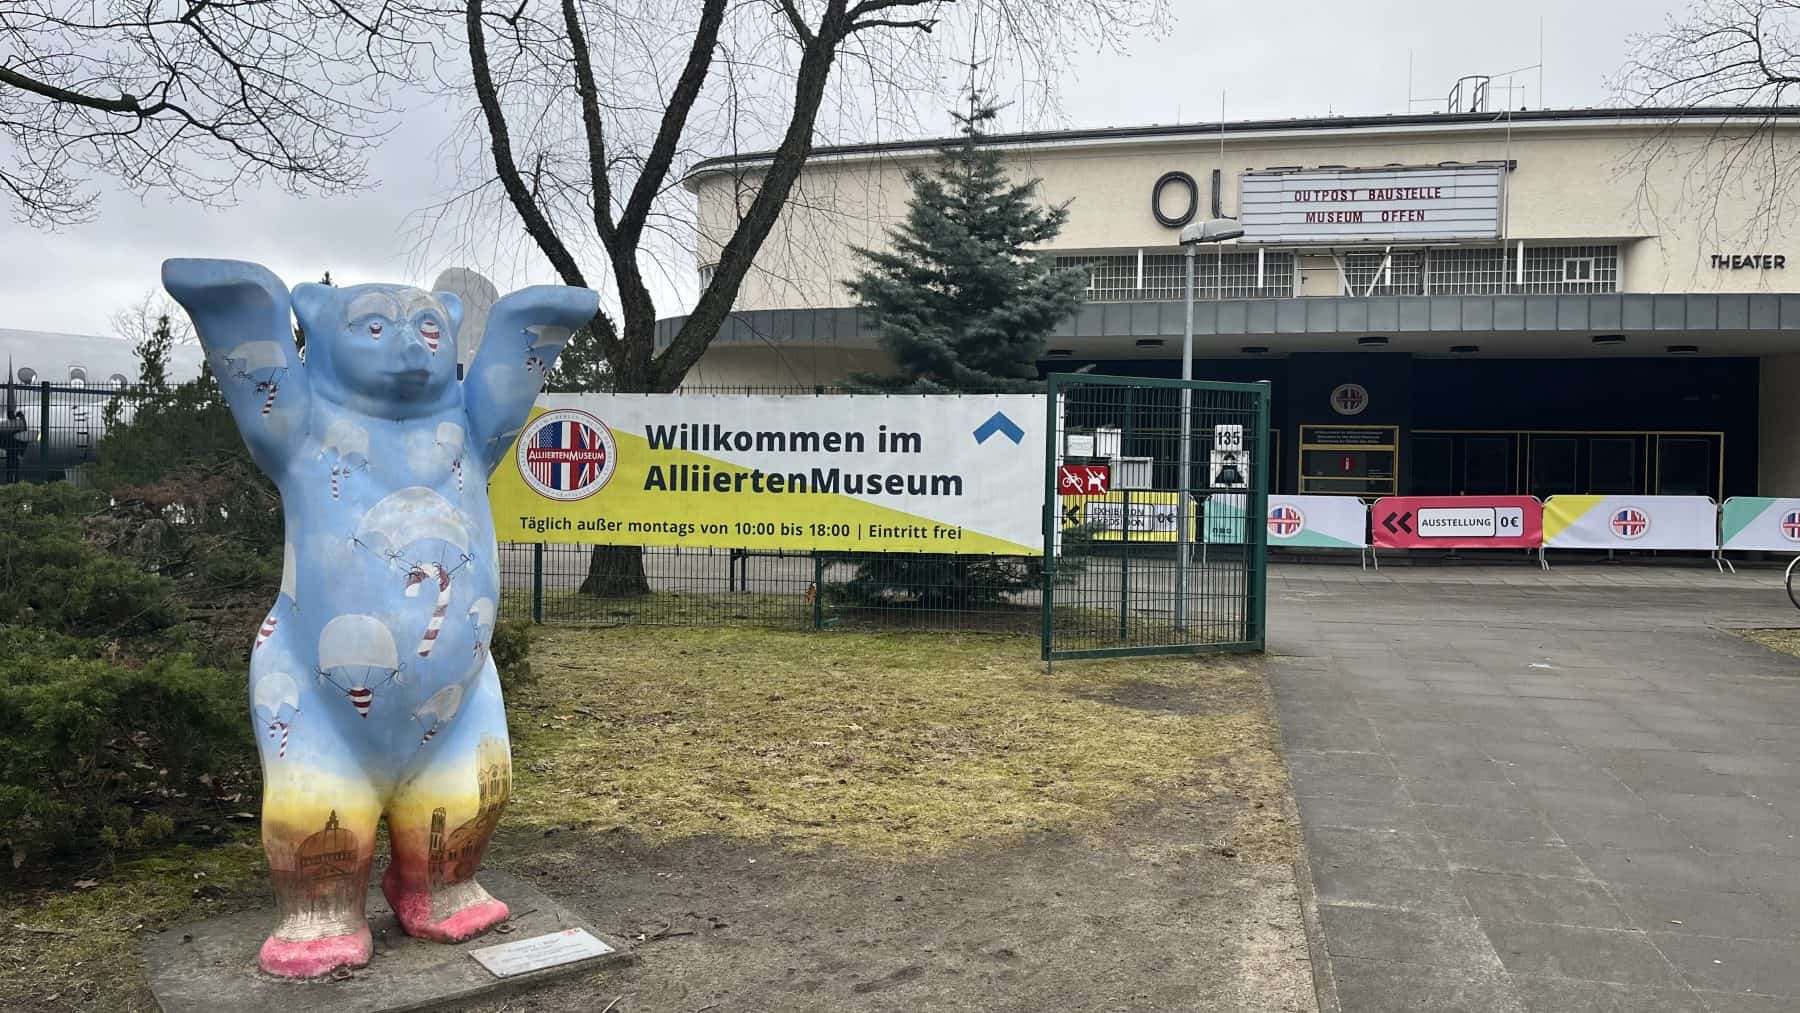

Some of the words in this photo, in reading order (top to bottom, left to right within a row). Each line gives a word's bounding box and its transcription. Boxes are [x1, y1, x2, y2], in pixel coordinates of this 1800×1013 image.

[1294, 190, 1356, 202] OUTPOST
[1368, 187, 1441, 200] BAUSTELLE
[1306, 211, 1363, 223] MUSEUM
[1381, 209, 1425, 222] OFFEN
[1711, 254, 1786, 269] THEATER
[645, 423, 865, 452] Willkommen
[878, 425, 922, 453] im
[1218, 431, 1240, 445] 135
[643, 464, 963, 496] AlliiertenMuseum
[520, 516, 572, 532] Täglich
[577, 518, 623, 531] außer
[628, 519, 695, 536] montags
[701, 523, 728, 534] von
[735, 522, 775, 535] 10:00
[781, 522, 803, 536] bis
[809, 524, 850, 537] 18:00
[869, 524, 927, 538] Eintritt
[934, 526, 962, 539] frei
[1421, 518, 1491, 527] AUSSTELLUNG
